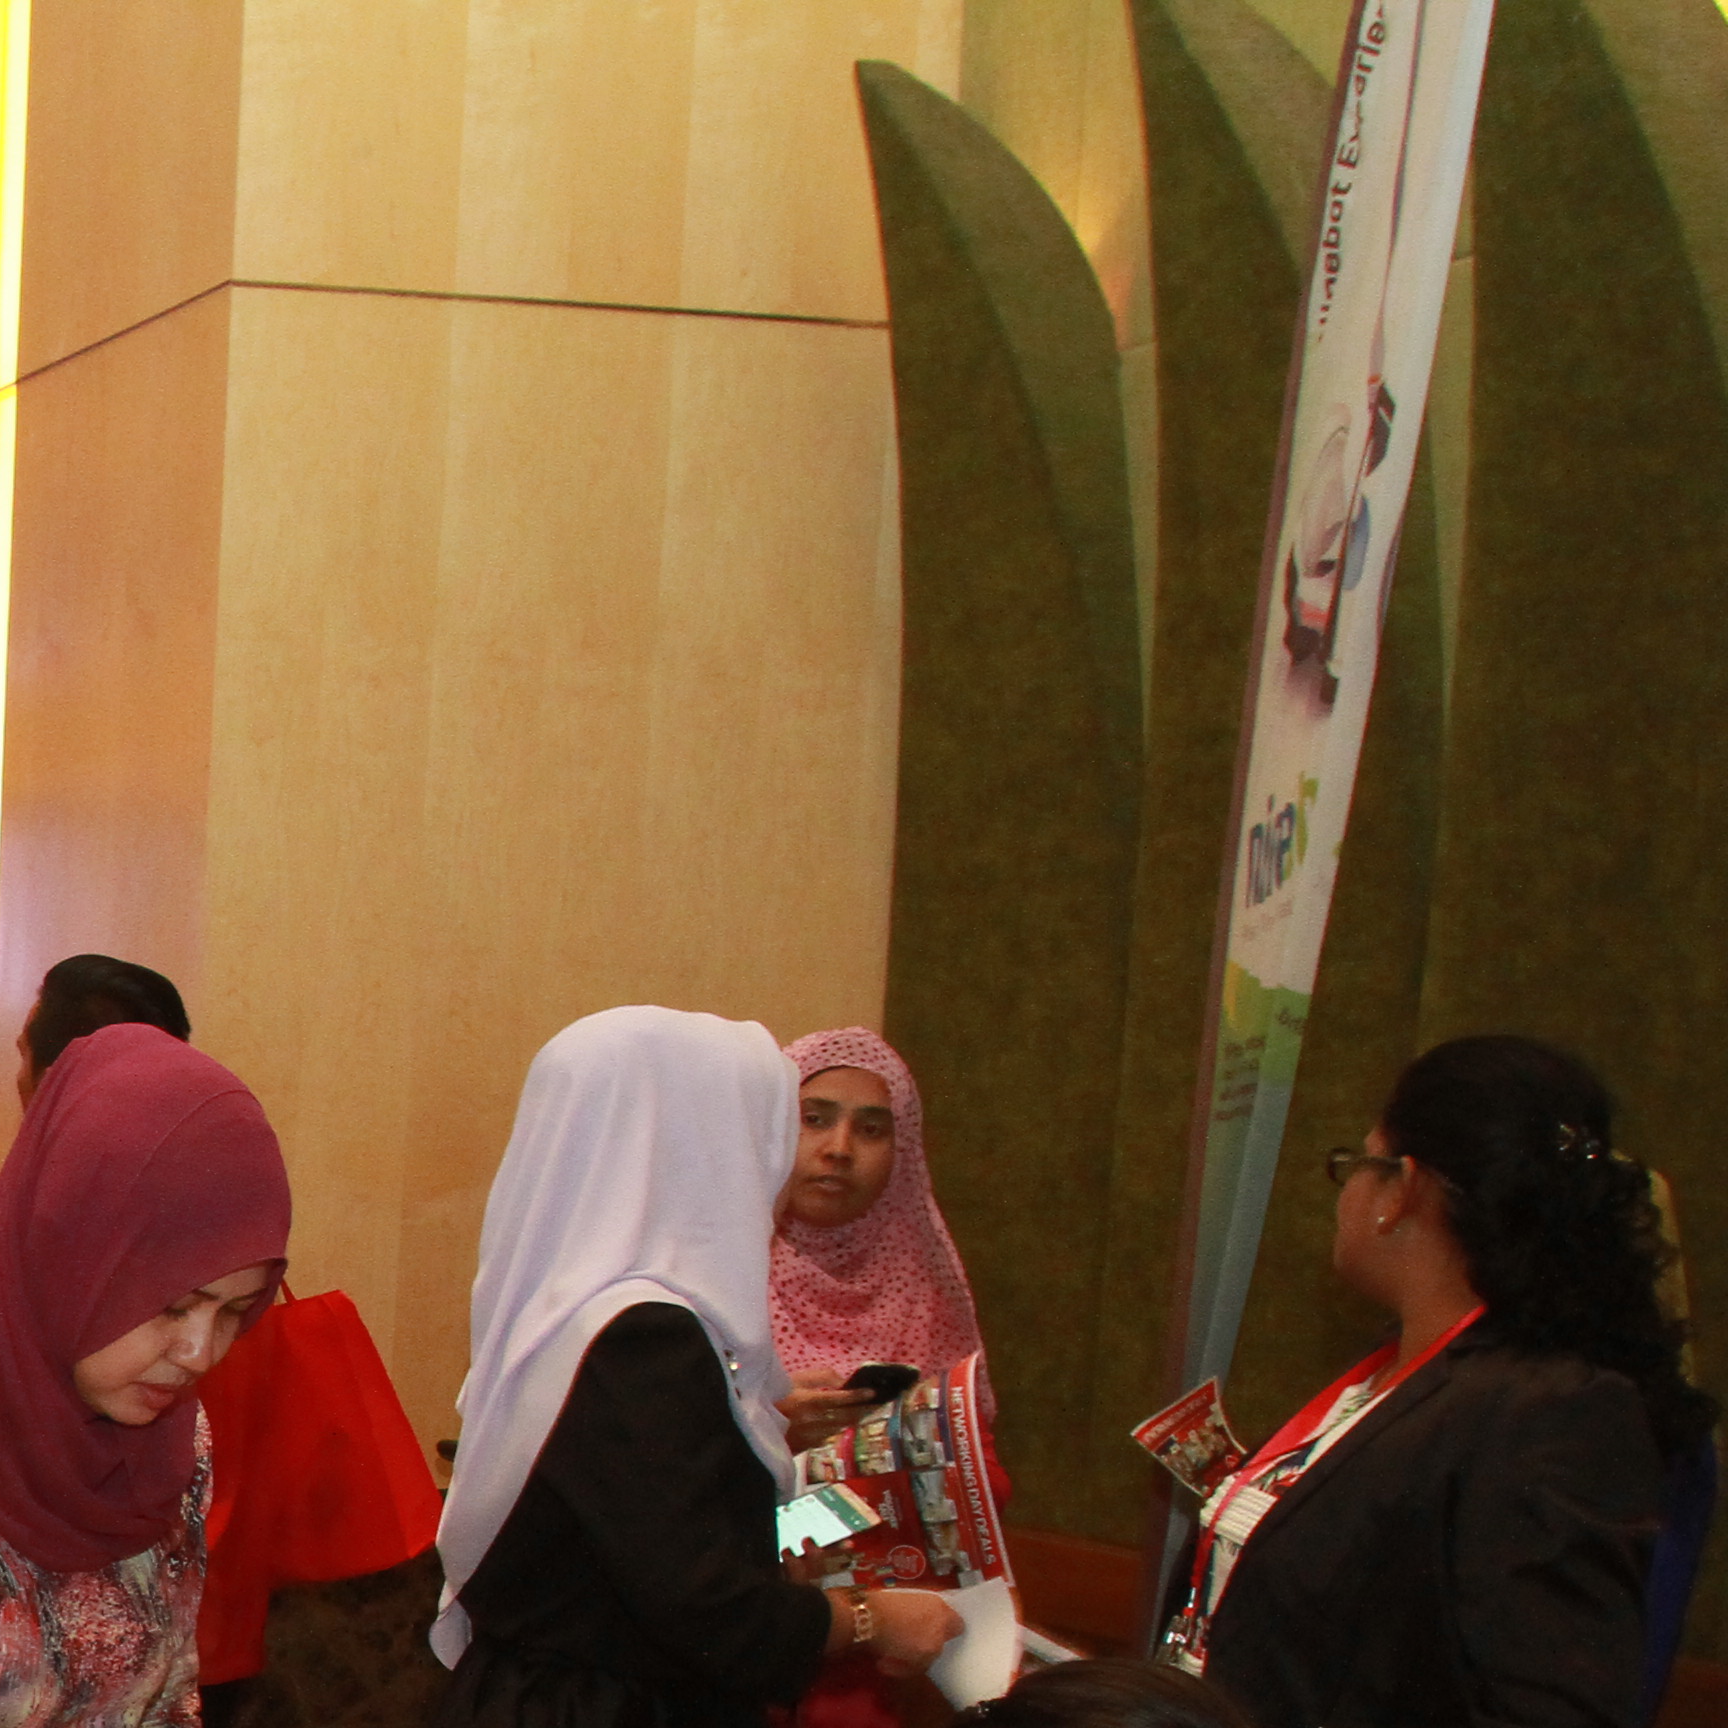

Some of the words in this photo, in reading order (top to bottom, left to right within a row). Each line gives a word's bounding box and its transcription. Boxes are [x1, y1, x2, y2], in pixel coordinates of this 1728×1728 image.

[950, 1386, 976, 1489] NETWORKING
[966, 1488, 985, 1520] DAY
[975, 1519, 997, 1565] DEALS
